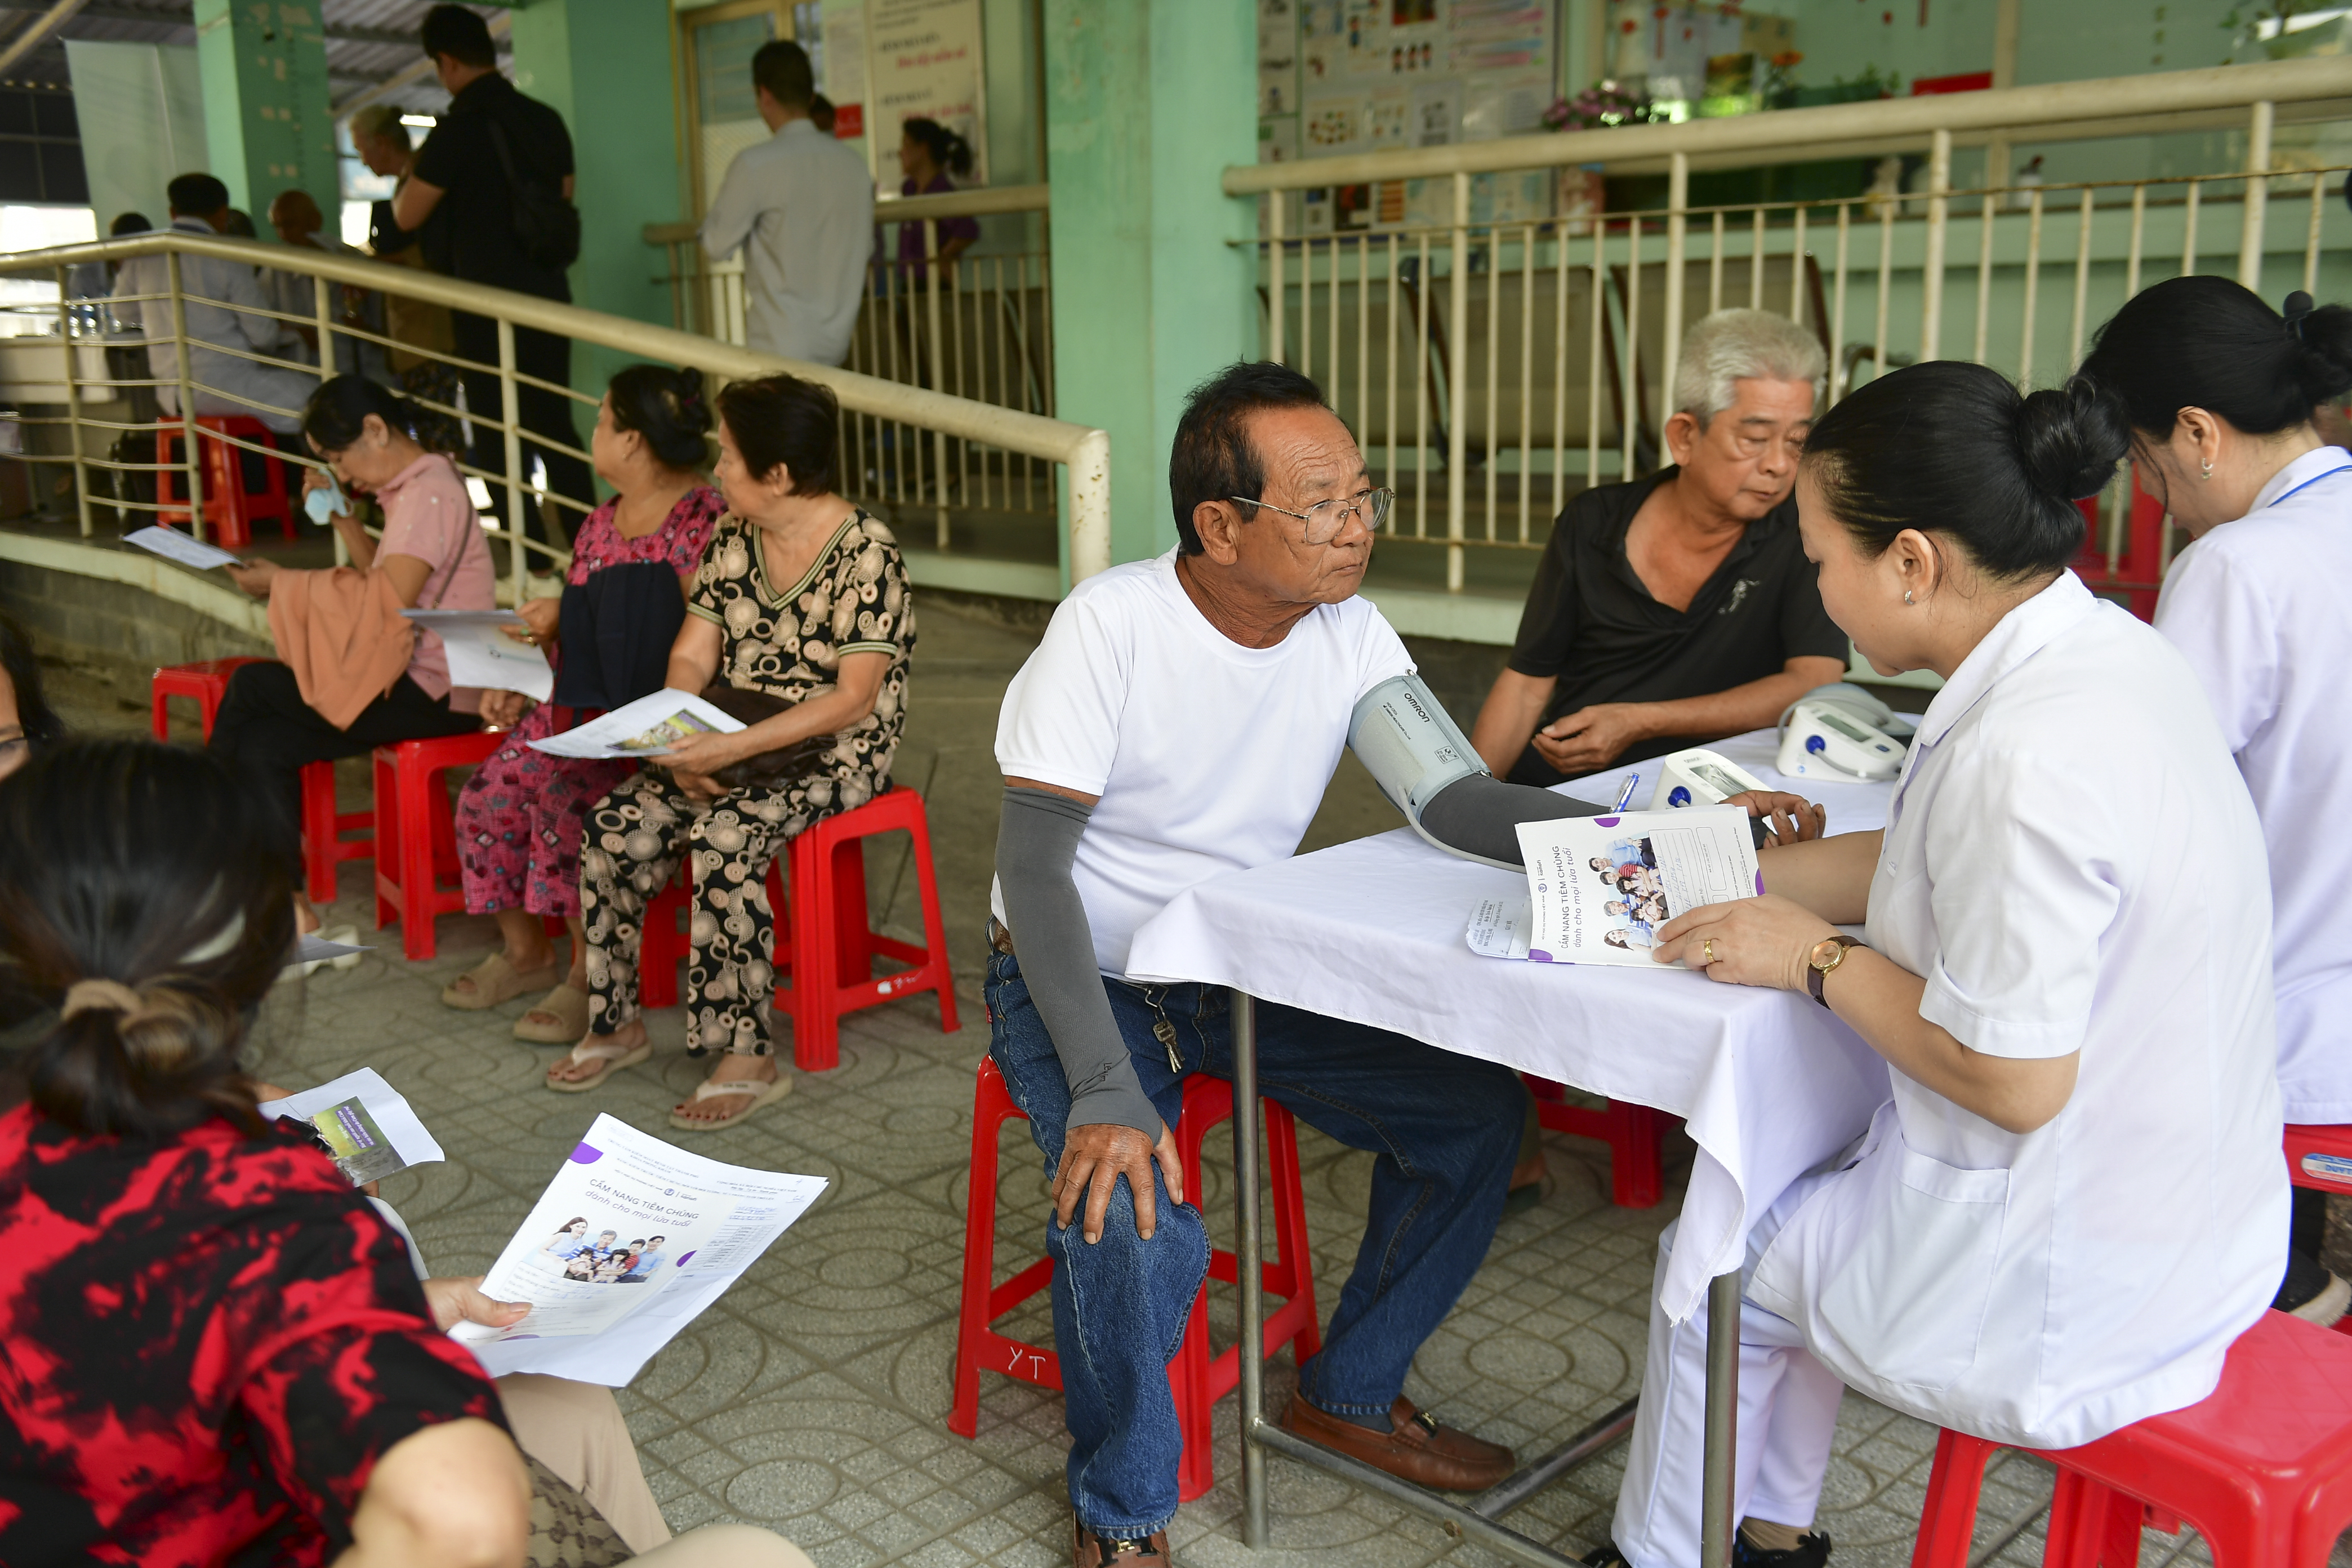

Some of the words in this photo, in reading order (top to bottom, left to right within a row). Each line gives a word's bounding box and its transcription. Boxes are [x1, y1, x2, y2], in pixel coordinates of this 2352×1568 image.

[1404, 693, 1430, 723] OMRON
[1385, 708, 1393, 717] OMRON
[1393, 717, 1405, 732] HEALTHCARE
[1552, 846, 1565, 878] CHỦNG
[1562, 848, 1574, 865] tuổi
[1569, 868, 1578, 883] lứa
[1558, 881, 1568, 903] TIÊM
[1571, 886, 1582, 905] mọi
[1574, 908, 1582, 925] cho
[1558, 934, 1569, 948] CẨM
[1573, 928, 1582, 947] dành
[585, 1191, 610, 1205] dành
[612, 1203, 630, 1213] cho
[631, 1211, 653, 1220] mọi
[653, 1215, 670, 1223] lứa
[612, 1190, 639, 1205] NANG
[642, 1201, 665, 1212] TIÊM
[666, 1208, 699, 1219] CHỦNG
